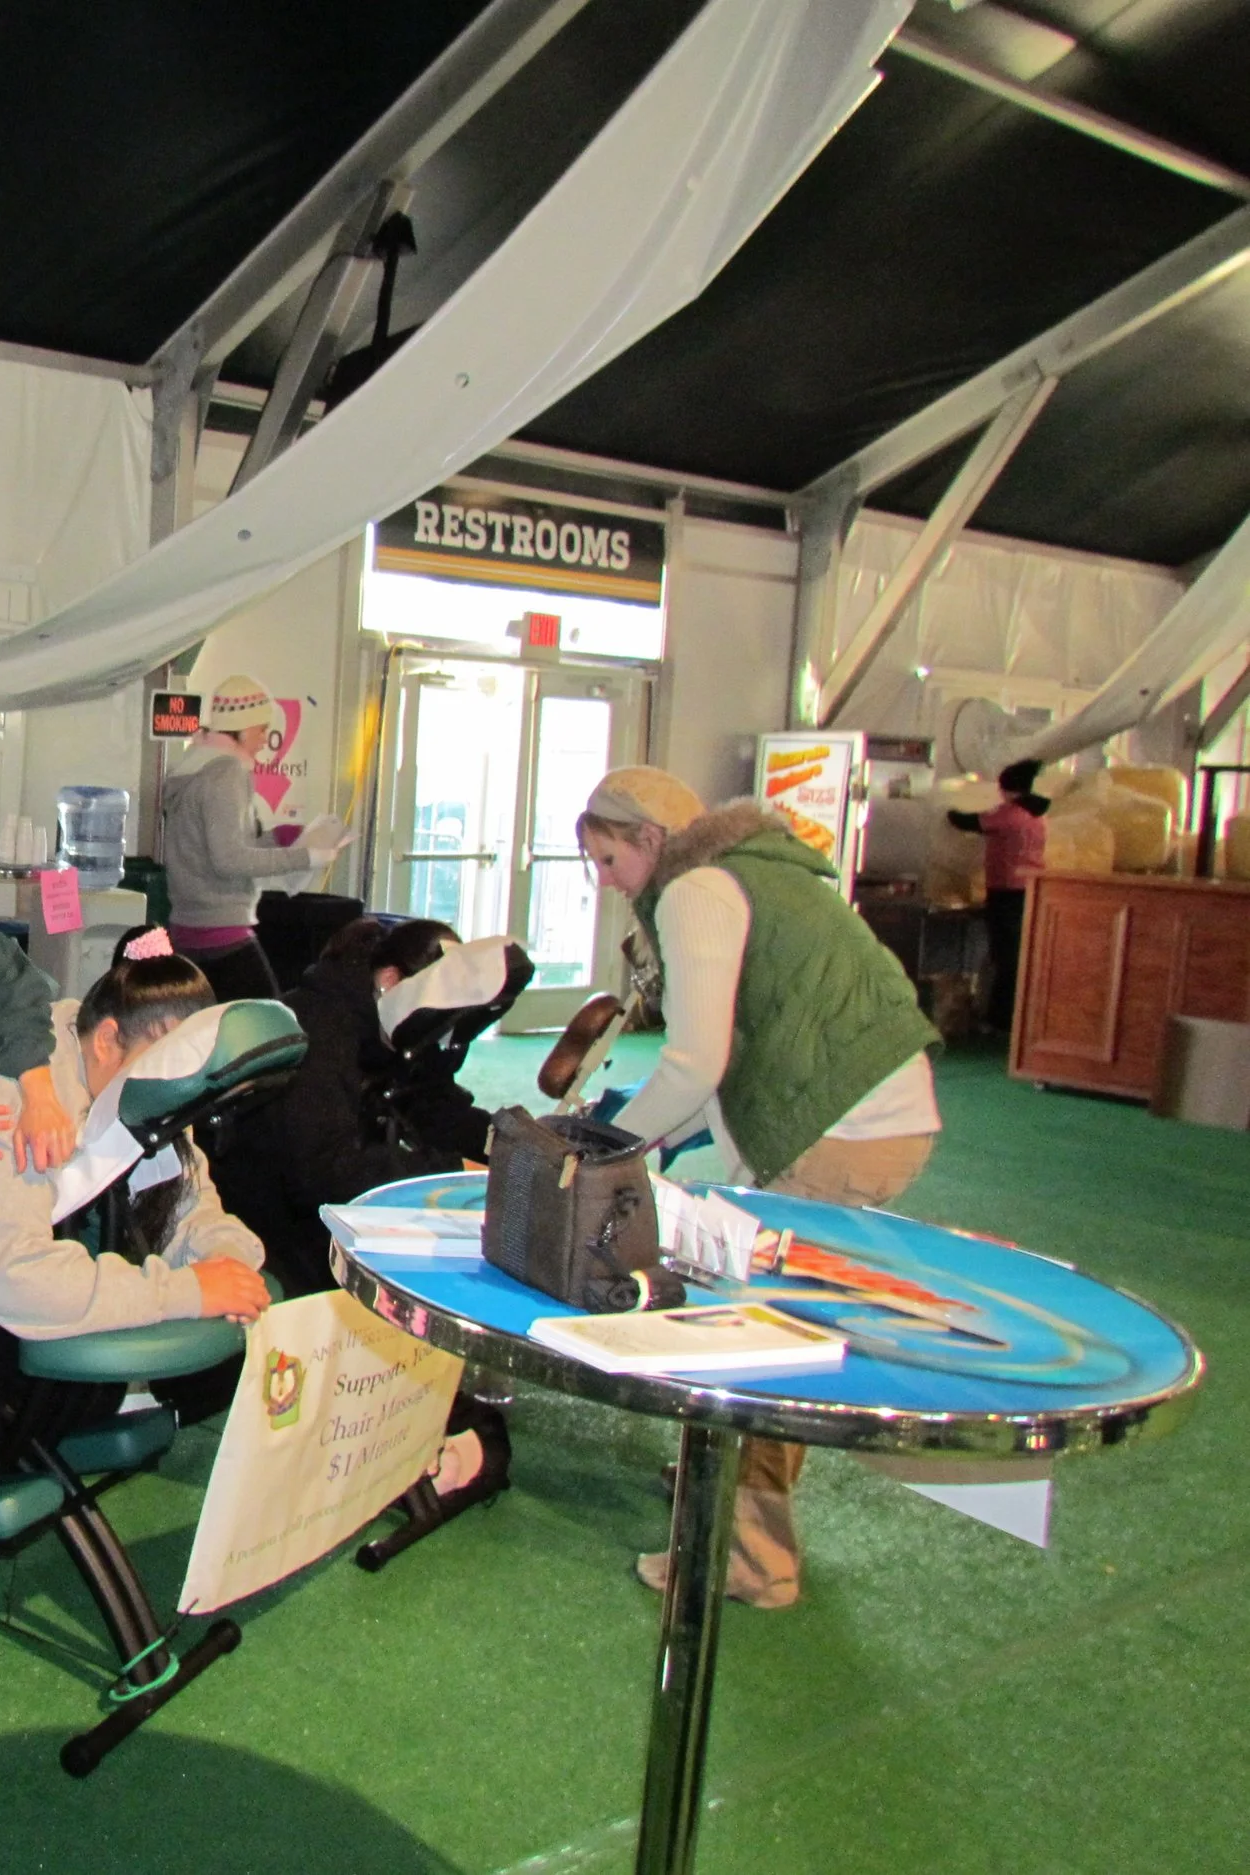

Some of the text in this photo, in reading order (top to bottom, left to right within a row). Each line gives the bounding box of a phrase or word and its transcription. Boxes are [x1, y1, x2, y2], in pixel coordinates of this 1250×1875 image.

[414, 500, 631, 571] RESTROOMS
[169, 696, 185, 714] NO
[154, 714, 200, 732] SMOKING
[253, 758, 308, 777] triders!
[334, 1360, 407, 1397] Supports
[319, 1411, 374, 1447] Chair
[326, 1453, 352, 1483] $1
